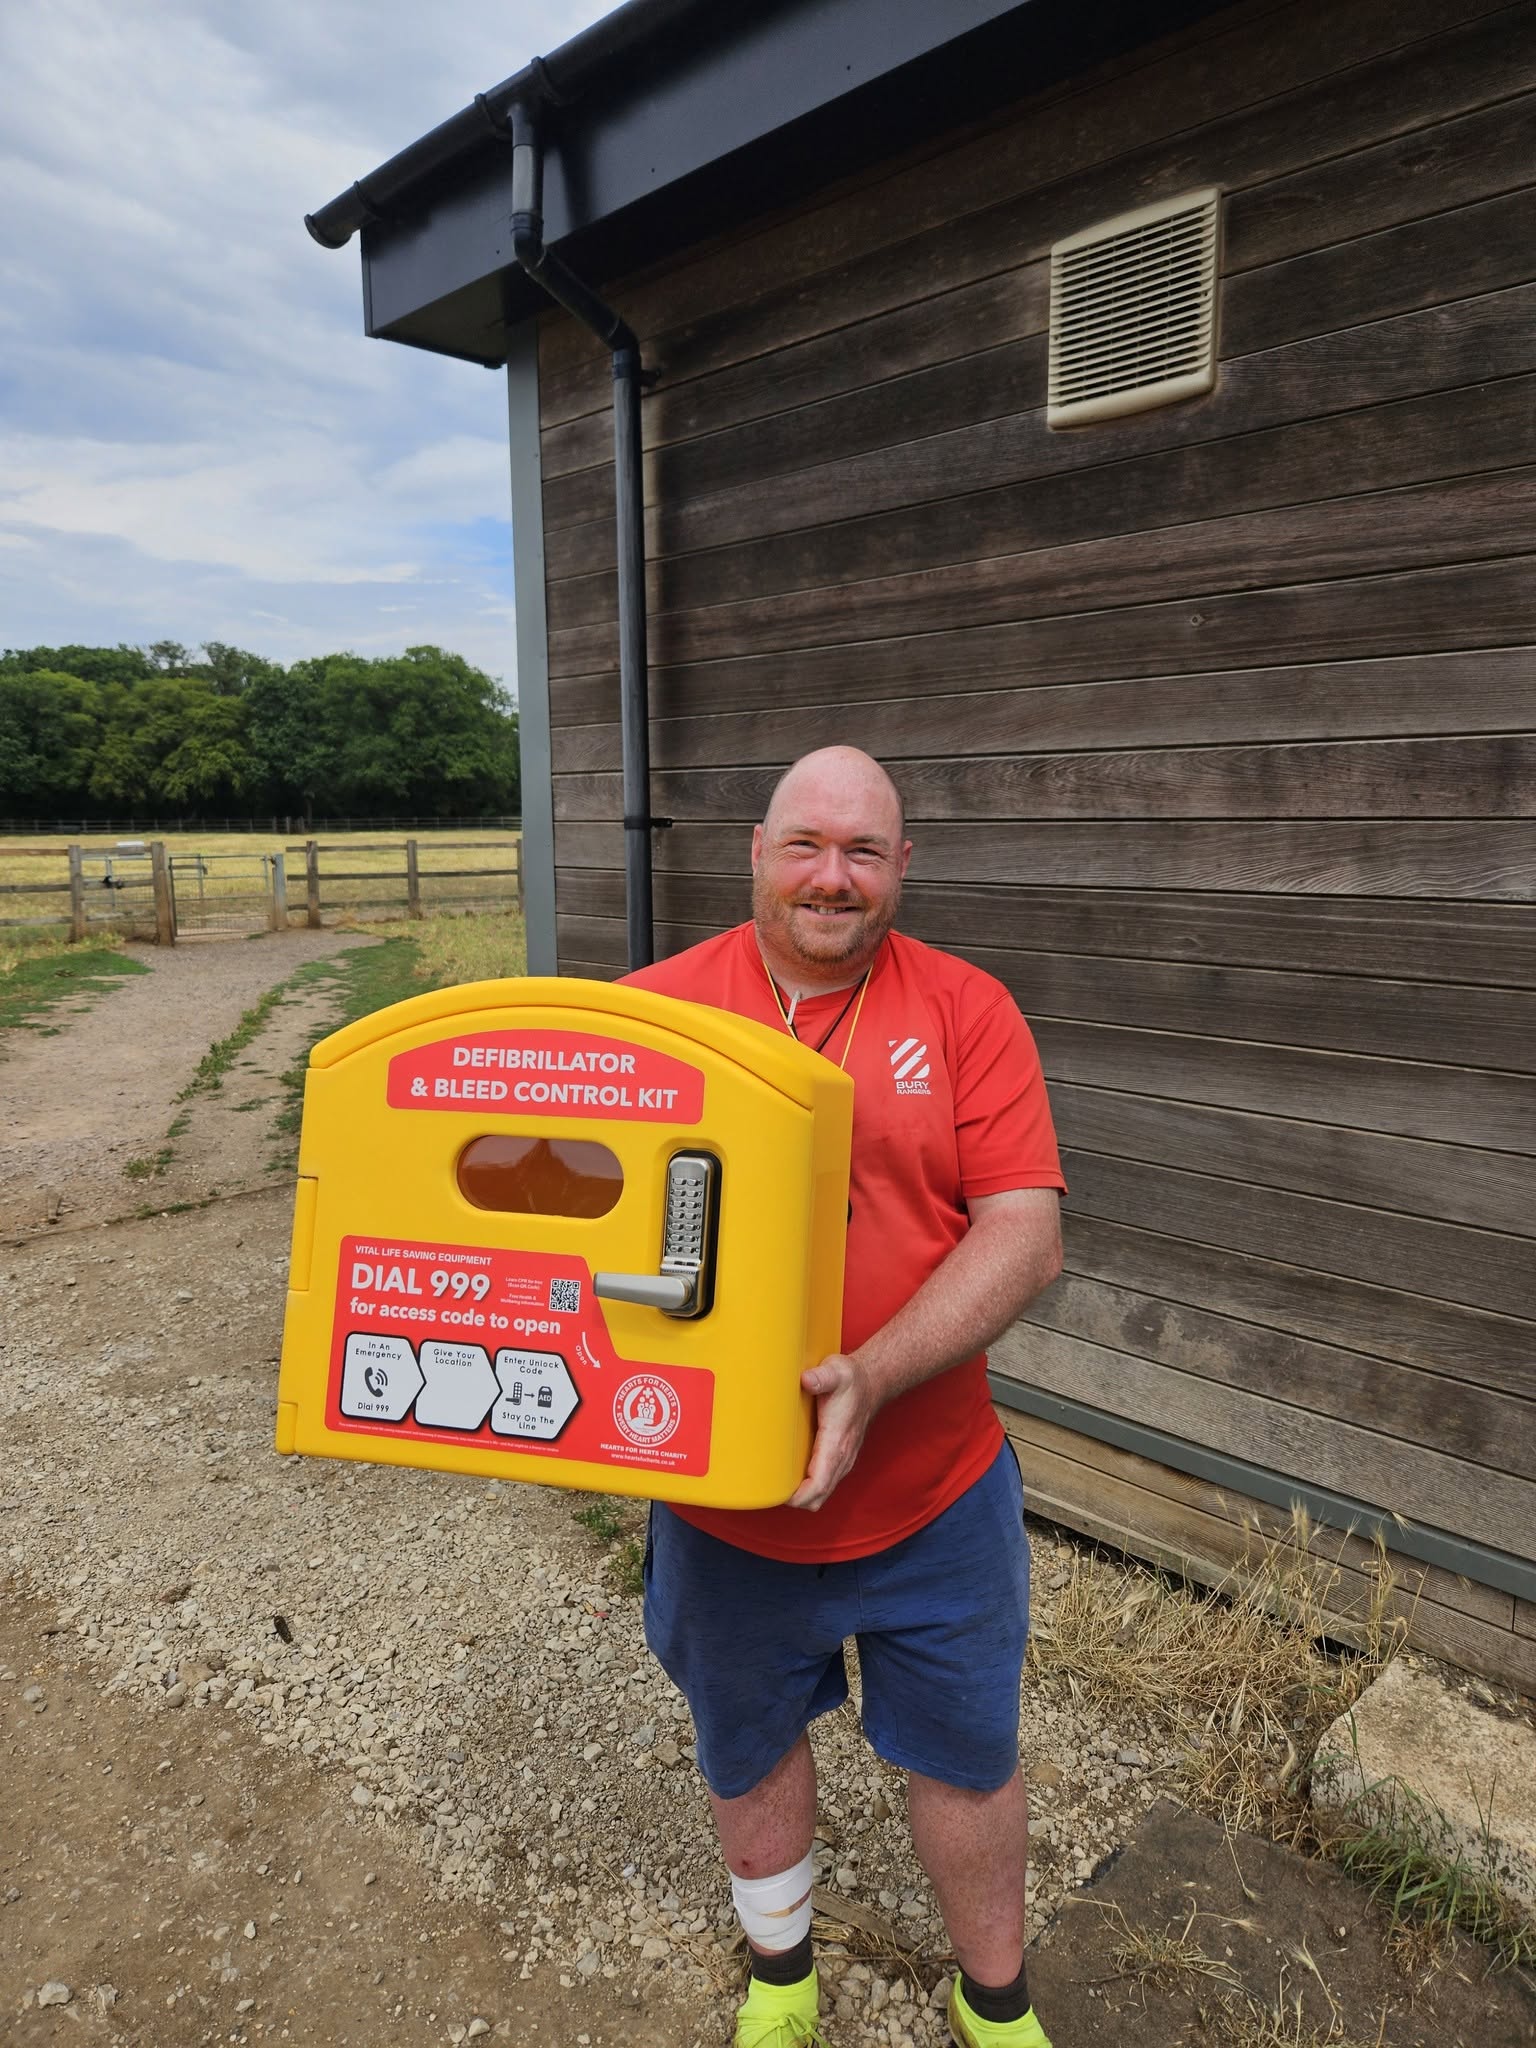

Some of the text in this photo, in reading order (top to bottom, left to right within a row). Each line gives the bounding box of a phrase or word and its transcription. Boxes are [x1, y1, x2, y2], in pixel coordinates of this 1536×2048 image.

[453, 1047, 636, 1074] DEFIBRILLATOR
[896, 1081, 929, 1089] BURY
[410, 1077, 679, 1110] & BLEED CONTROL KIT
[355, 1245, 492, 1266] VITAL LIFE SAVING EQUIPMENT
[351, 1262, 491, 1301] DIAL 999
[350, 1296, 561, 1336] for access code to open
[368, 1342, 391, 1351] In An
[355, 1348, 402, 1361] Emergency
[433, 1349, 476, 1360] Give Your
[435, 1356, 472, 1367] Location
[504, 1356, 560, 1369] Enter Unlock
[519, 1365, 543, 1376] Code
[538, 1393, 552, 1402] AED
[618, 1378, 677, 1408] HEARTS FOR HERTS
[357, 1401, 390, 1413] Dial 999
[502, 1411, 555, 1425] Stay On The
[519, 1421, 537, 1431] Line
[616, 1412, 676, 1443] EVERY HEART MATTERS
[600, 1443, 688, 1460] HEARTS FOR HERTS CHARITY
